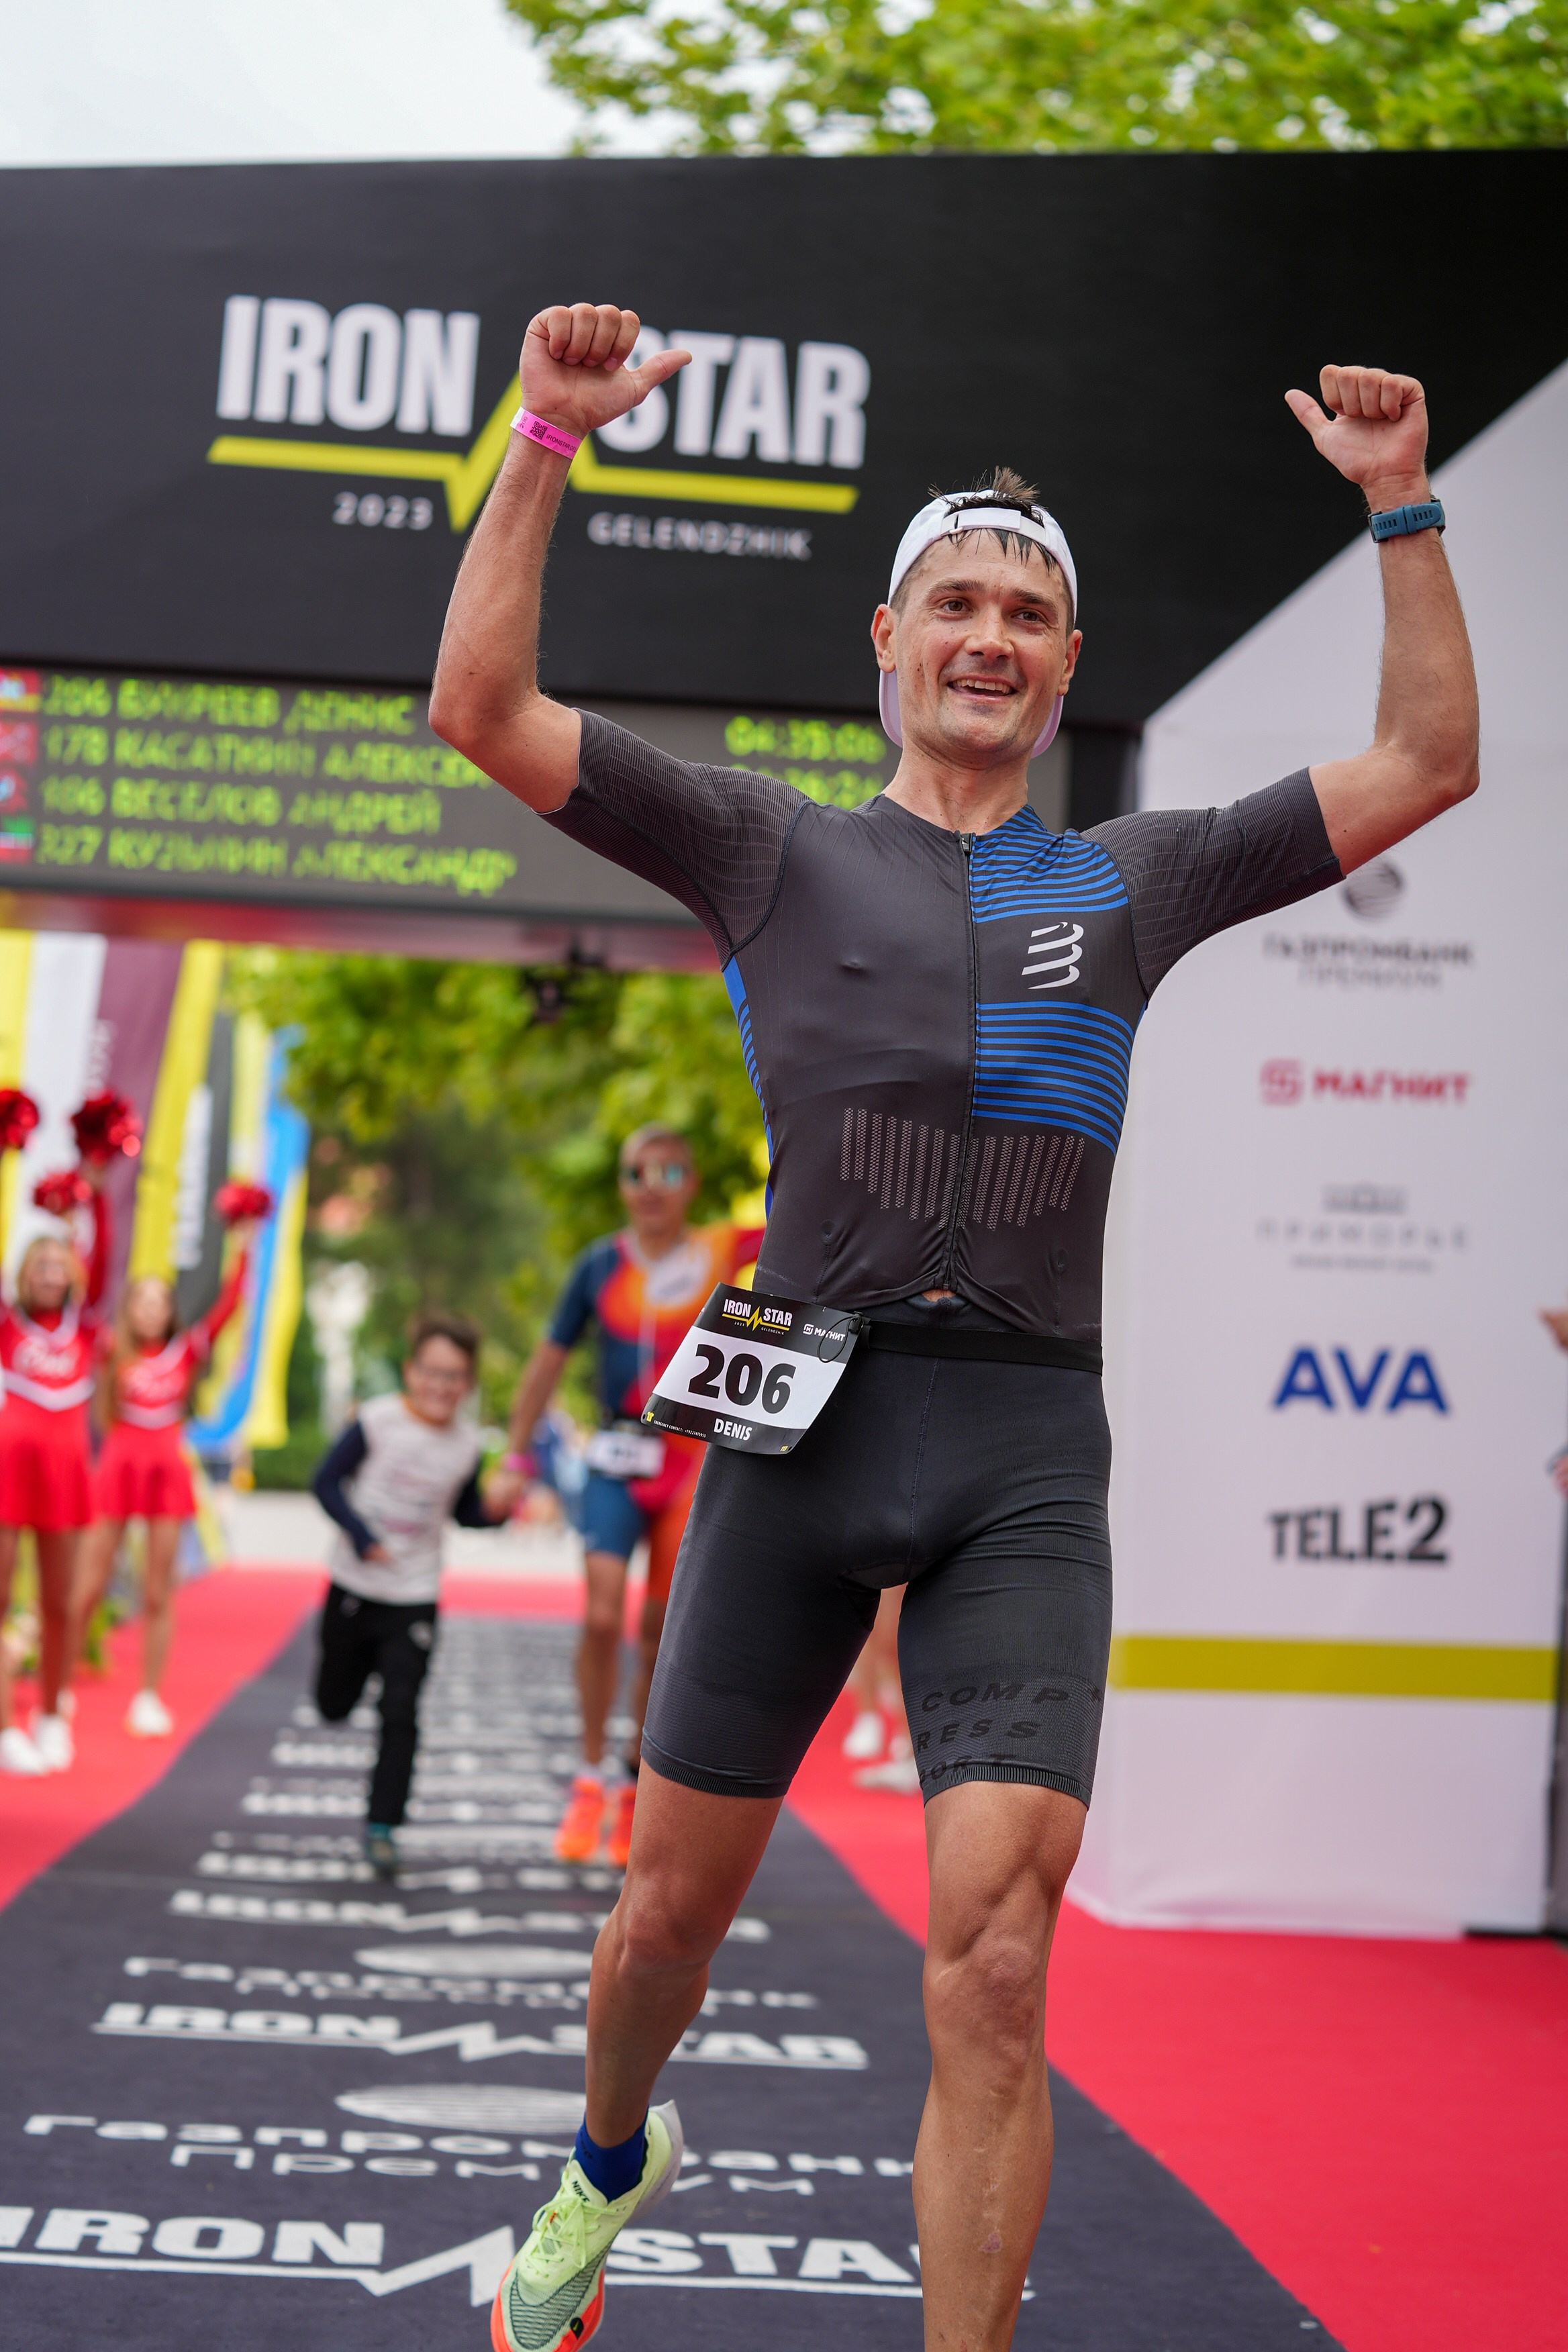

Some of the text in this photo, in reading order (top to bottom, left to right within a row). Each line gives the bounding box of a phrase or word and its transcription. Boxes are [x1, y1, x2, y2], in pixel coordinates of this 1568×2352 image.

[215, 295, 871, 470] IRON STAR
[546, 434, 571, 450] IRONSTAR
[333, 492, 433, 531] 2023
[587, 512, 812, 561] GELENDZHIK
[1312, 1069, 1470, 1103] МАГНИТ
[723, 1298, 793, 1326] IRON STAR
[814, 1327, 846, 1342] МАГНИТ
[688, 1343, 797, 1414] 206
[1273, 1347, 1451, 1414] AVA
[714, 1418, 752, 1441] DENIS
[1268, 1495, 1449, 1564] TELE2
[921, 1681, 1070, 1713] COMP
[102, 2003, 401, 2042] IRON
[571, 2180, 591, 2203] NIKE
[0, 2206, 921, 2284] IRON STA
